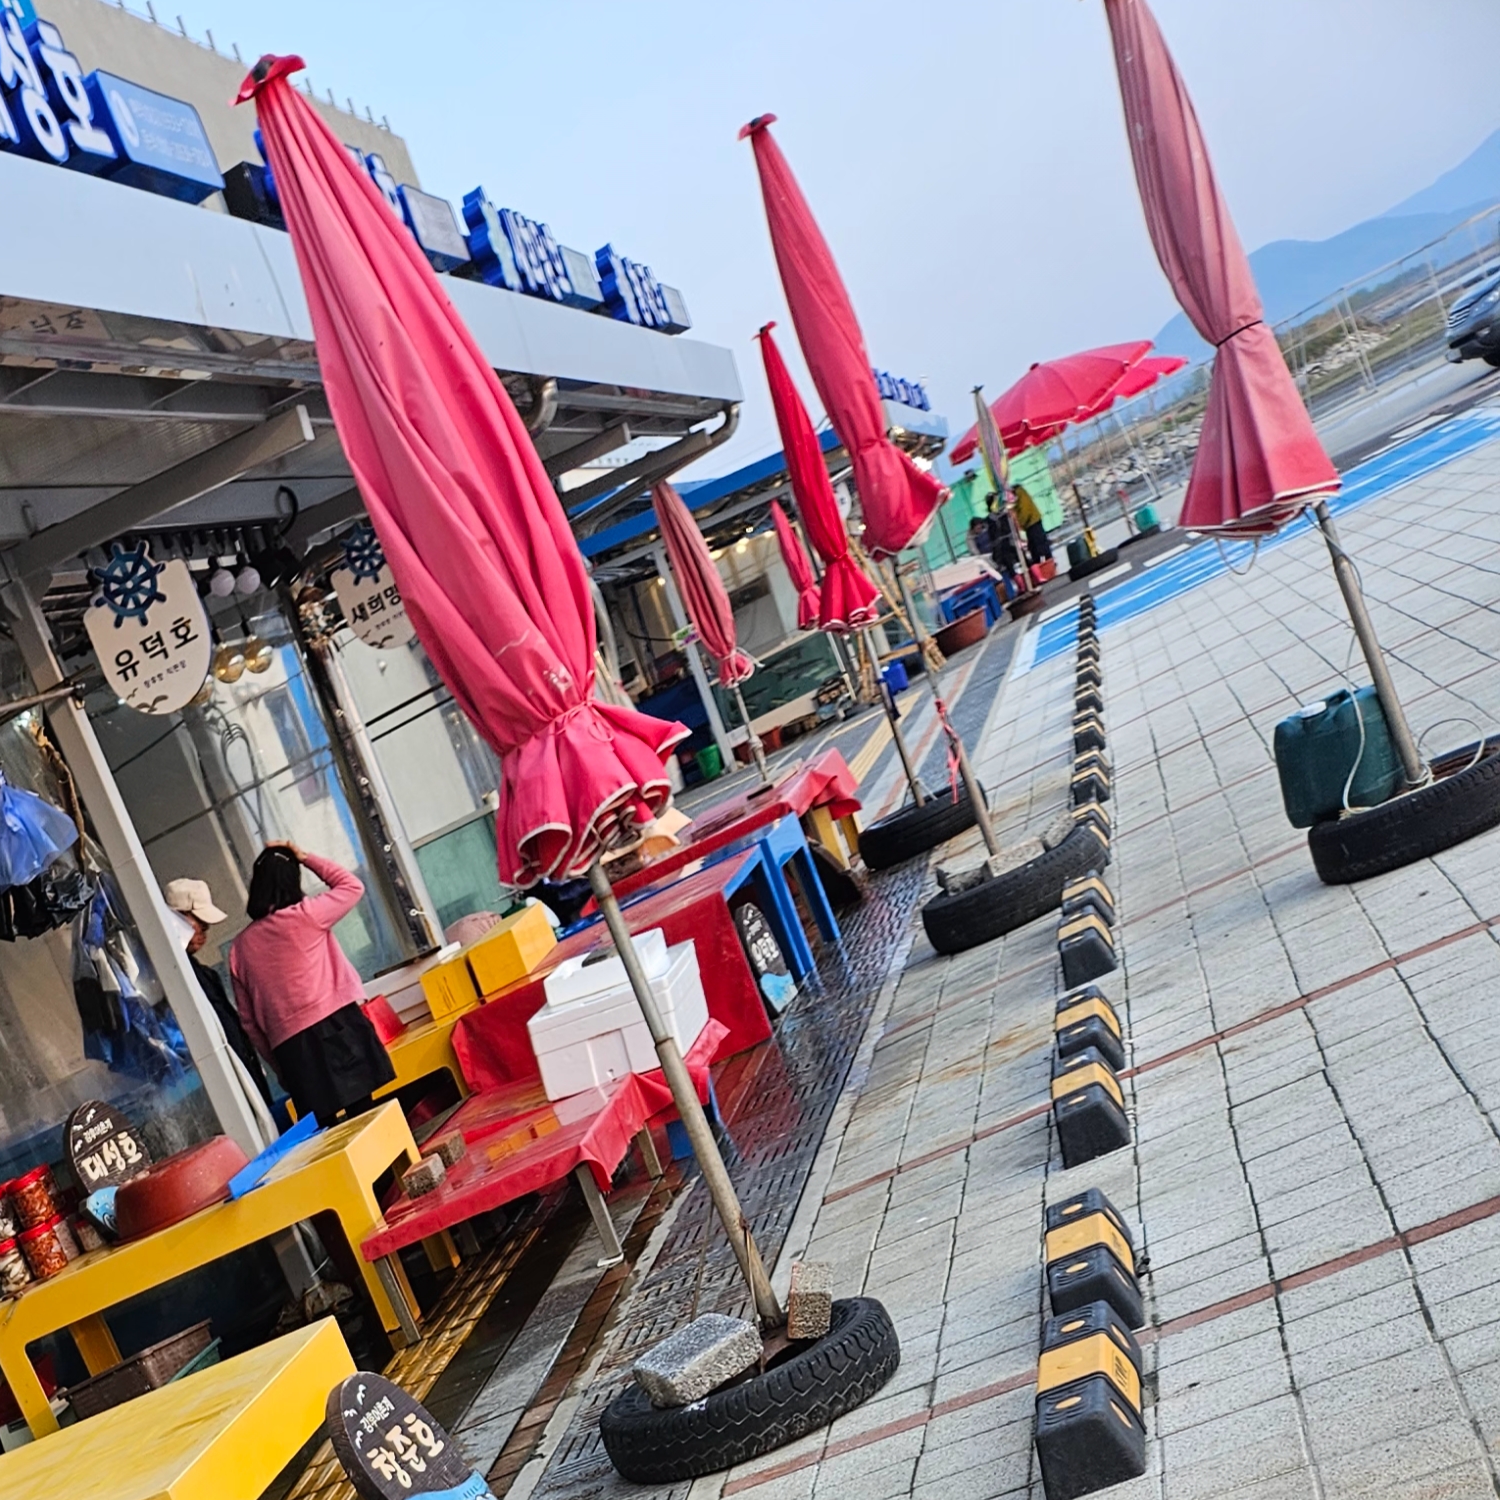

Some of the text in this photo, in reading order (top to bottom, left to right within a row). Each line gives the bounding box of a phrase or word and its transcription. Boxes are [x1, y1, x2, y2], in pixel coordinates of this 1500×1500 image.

[351, 583, 402, 624] 새희망
[114, 615, 200, 682] 유덕호
[80, 1131, 143, 1182] 대성호
[365, 1412, 445, 1489] 창준호
